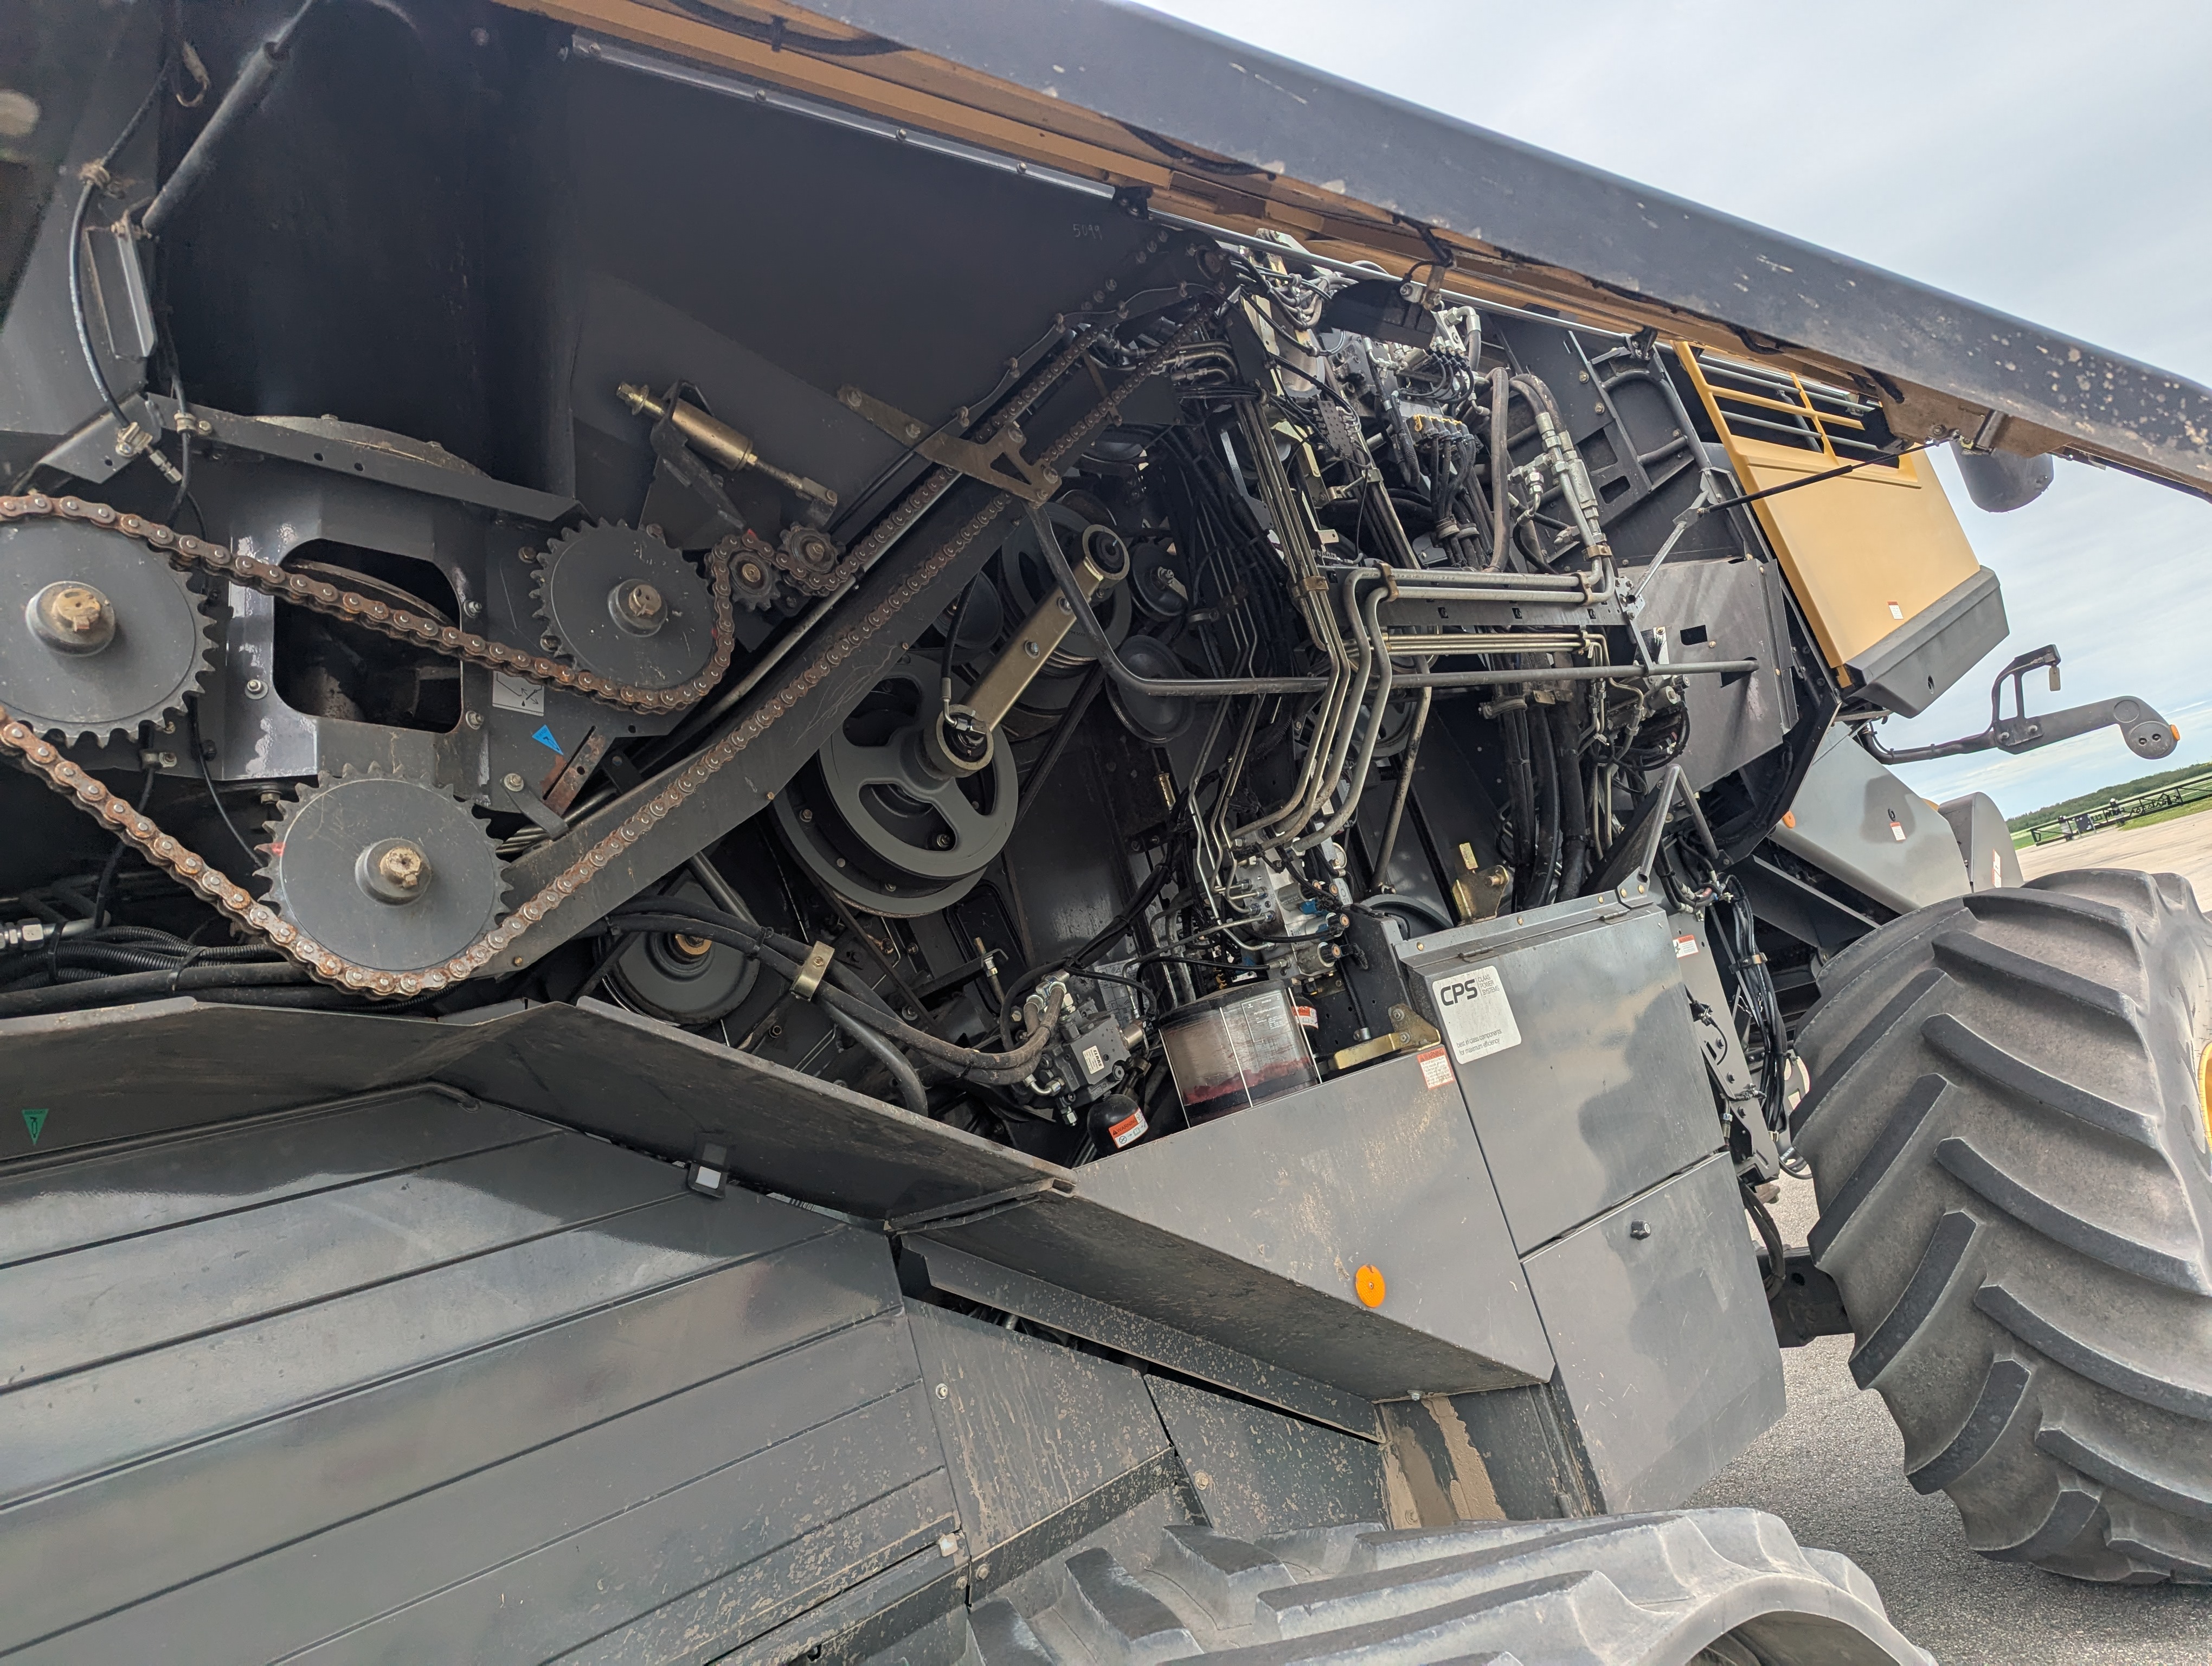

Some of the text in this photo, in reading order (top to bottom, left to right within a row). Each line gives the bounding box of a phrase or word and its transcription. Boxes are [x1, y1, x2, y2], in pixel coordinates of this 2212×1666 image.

[1477, 975, 1491, 983] CLAAS
[1480, 980, 1495, 989] POWER
[1441, 979, 1478, 1007] CPS
[1482, 985, 1500, 995] SYSTEMS
[1479, 1029, 1502, 1039] components
[1465, 1043, 1483, 1054] maximum
[1483, 1038, 1500, 1048] efficiency
[1093, 1050, 1103, 1067] CLAAS
[1424, 1048, 1444, 1059] WARNING
[1117, 1119, 1137, 1132] WARNING
